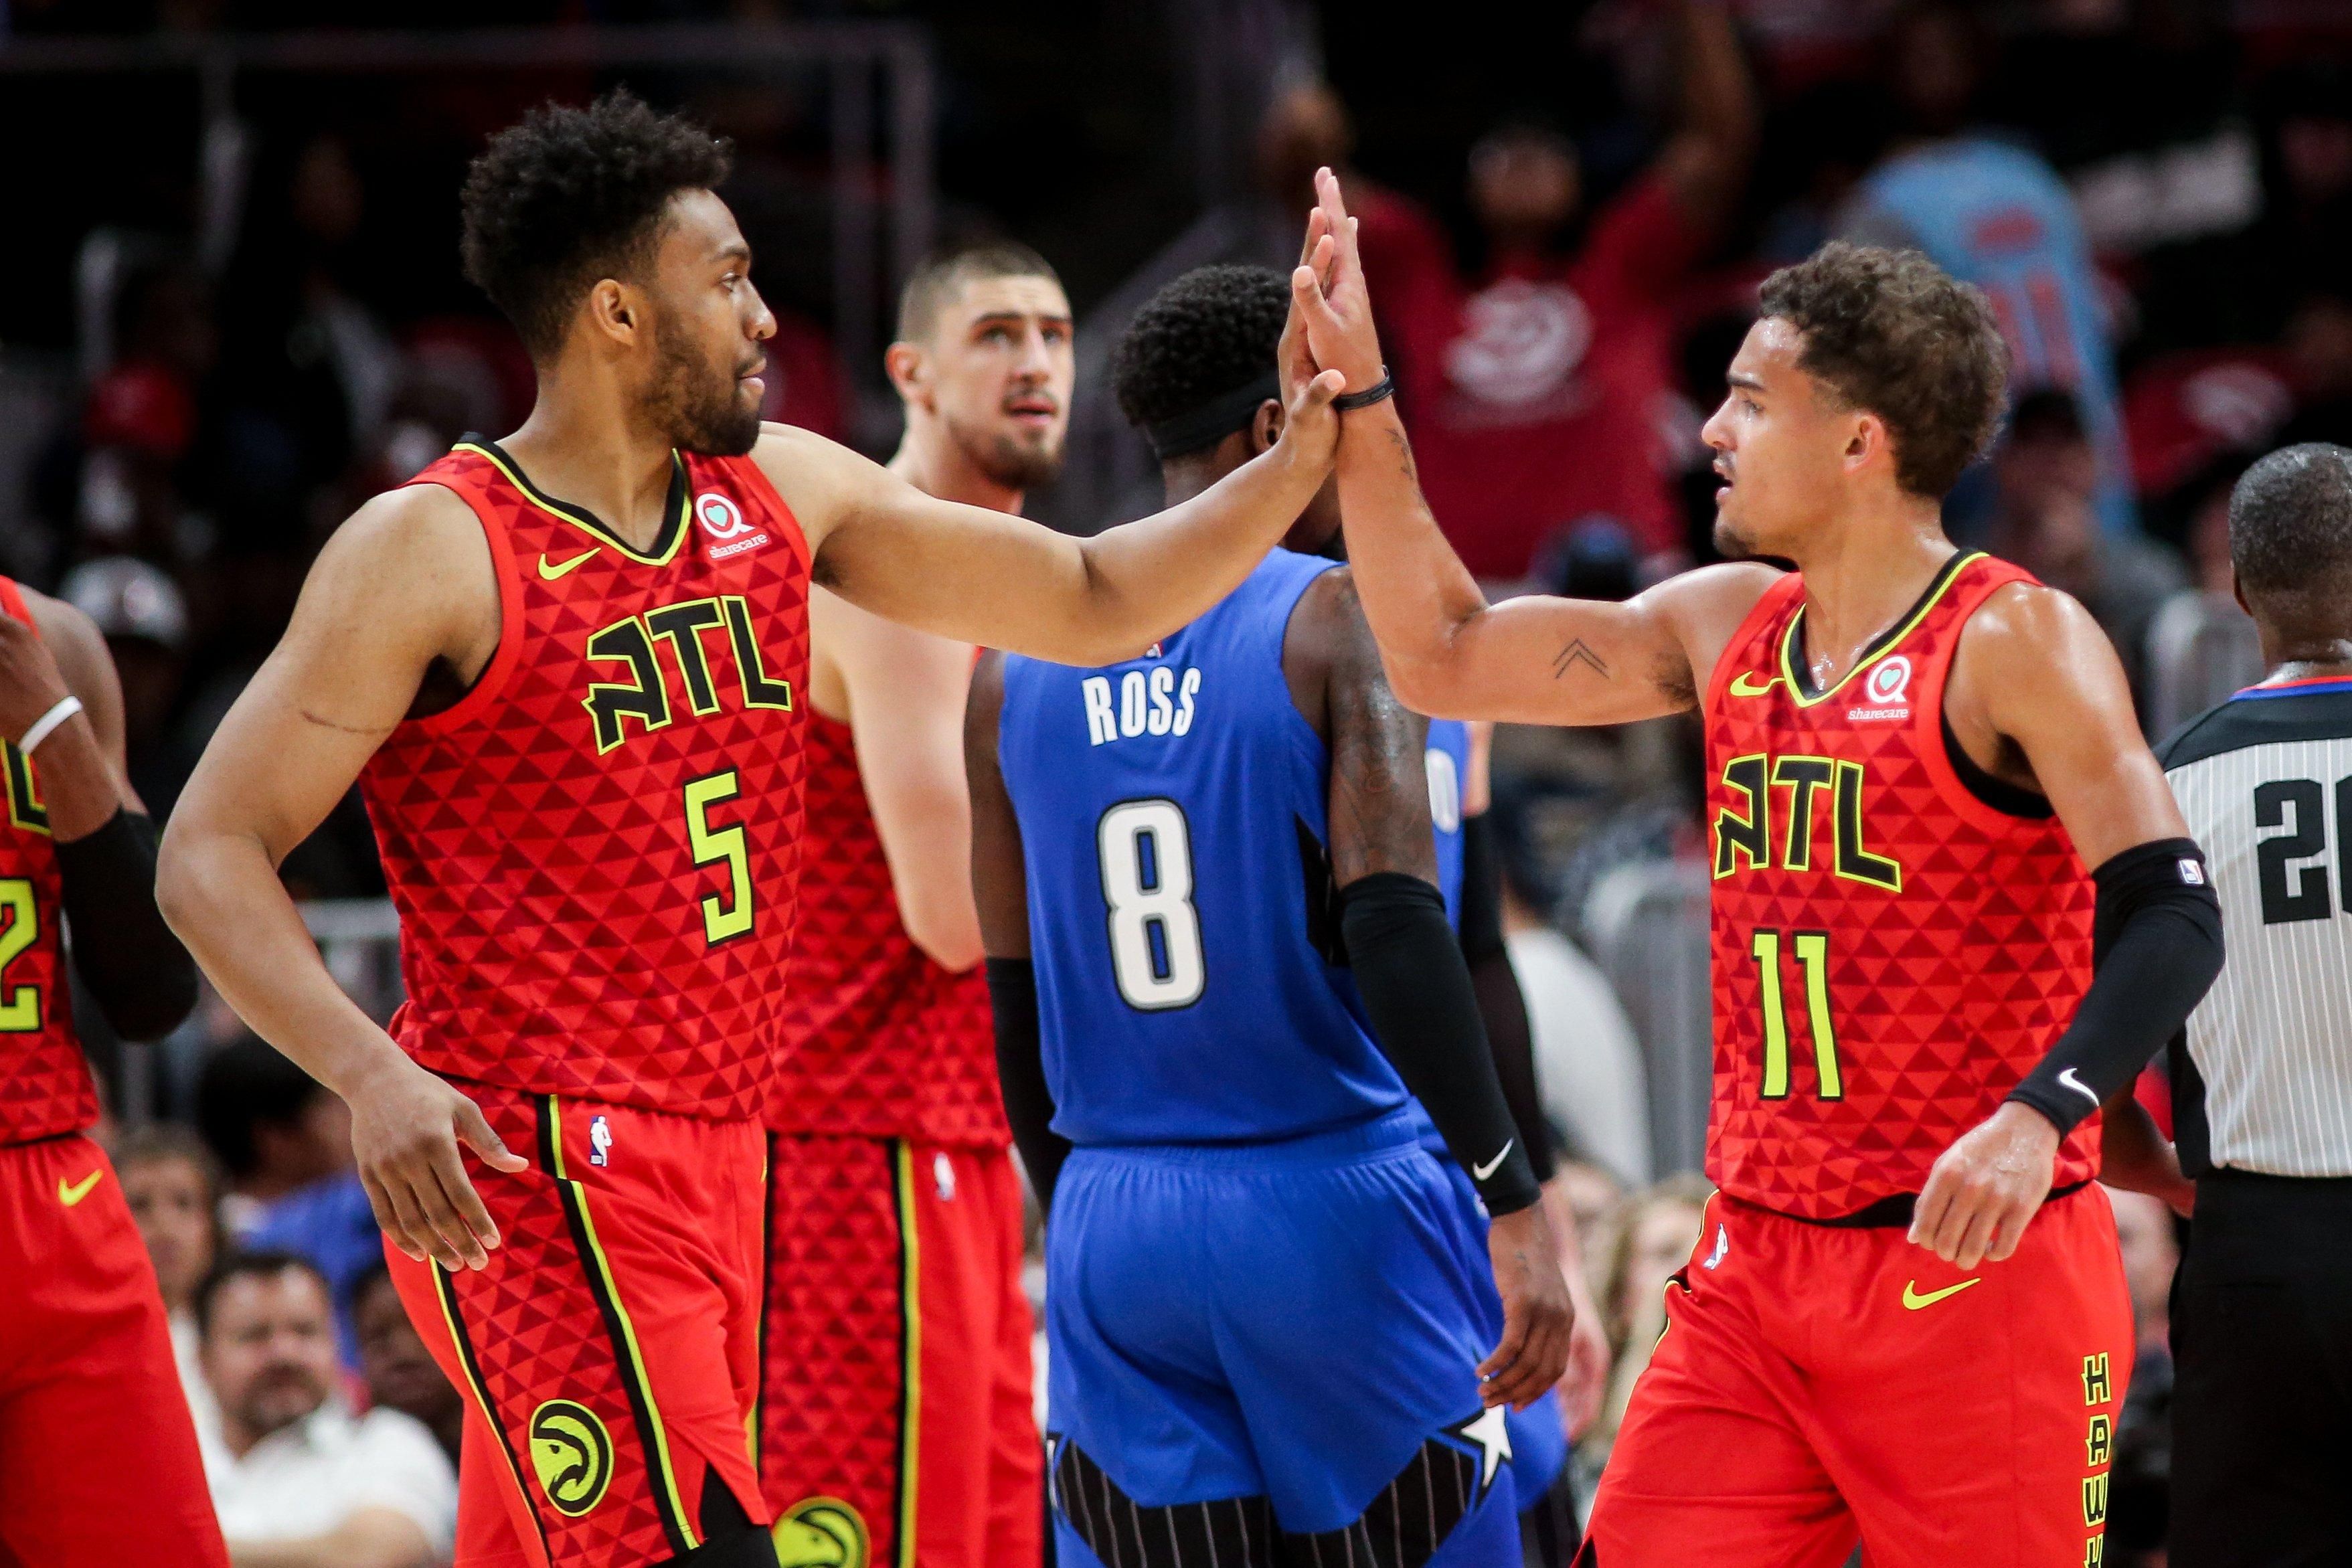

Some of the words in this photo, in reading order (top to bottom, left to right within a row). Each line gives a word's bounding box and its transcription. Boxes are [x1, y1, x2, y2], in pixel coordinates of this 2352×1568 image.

[709, 534, 768, 559] sharecare
[580, 595, 792, 755] ATL
[1081, 666, 1202, 748] ROSS
[1847, 707, 1909, 720] sharecare
[683, 768, 755, 946] 5
[1713, 752, 1902, 893] ATL
[2254, 774, 2352, 925] 2
[1096, 797, 1207, 1013] 8
[1751, 930, 1844, 1101] 11
